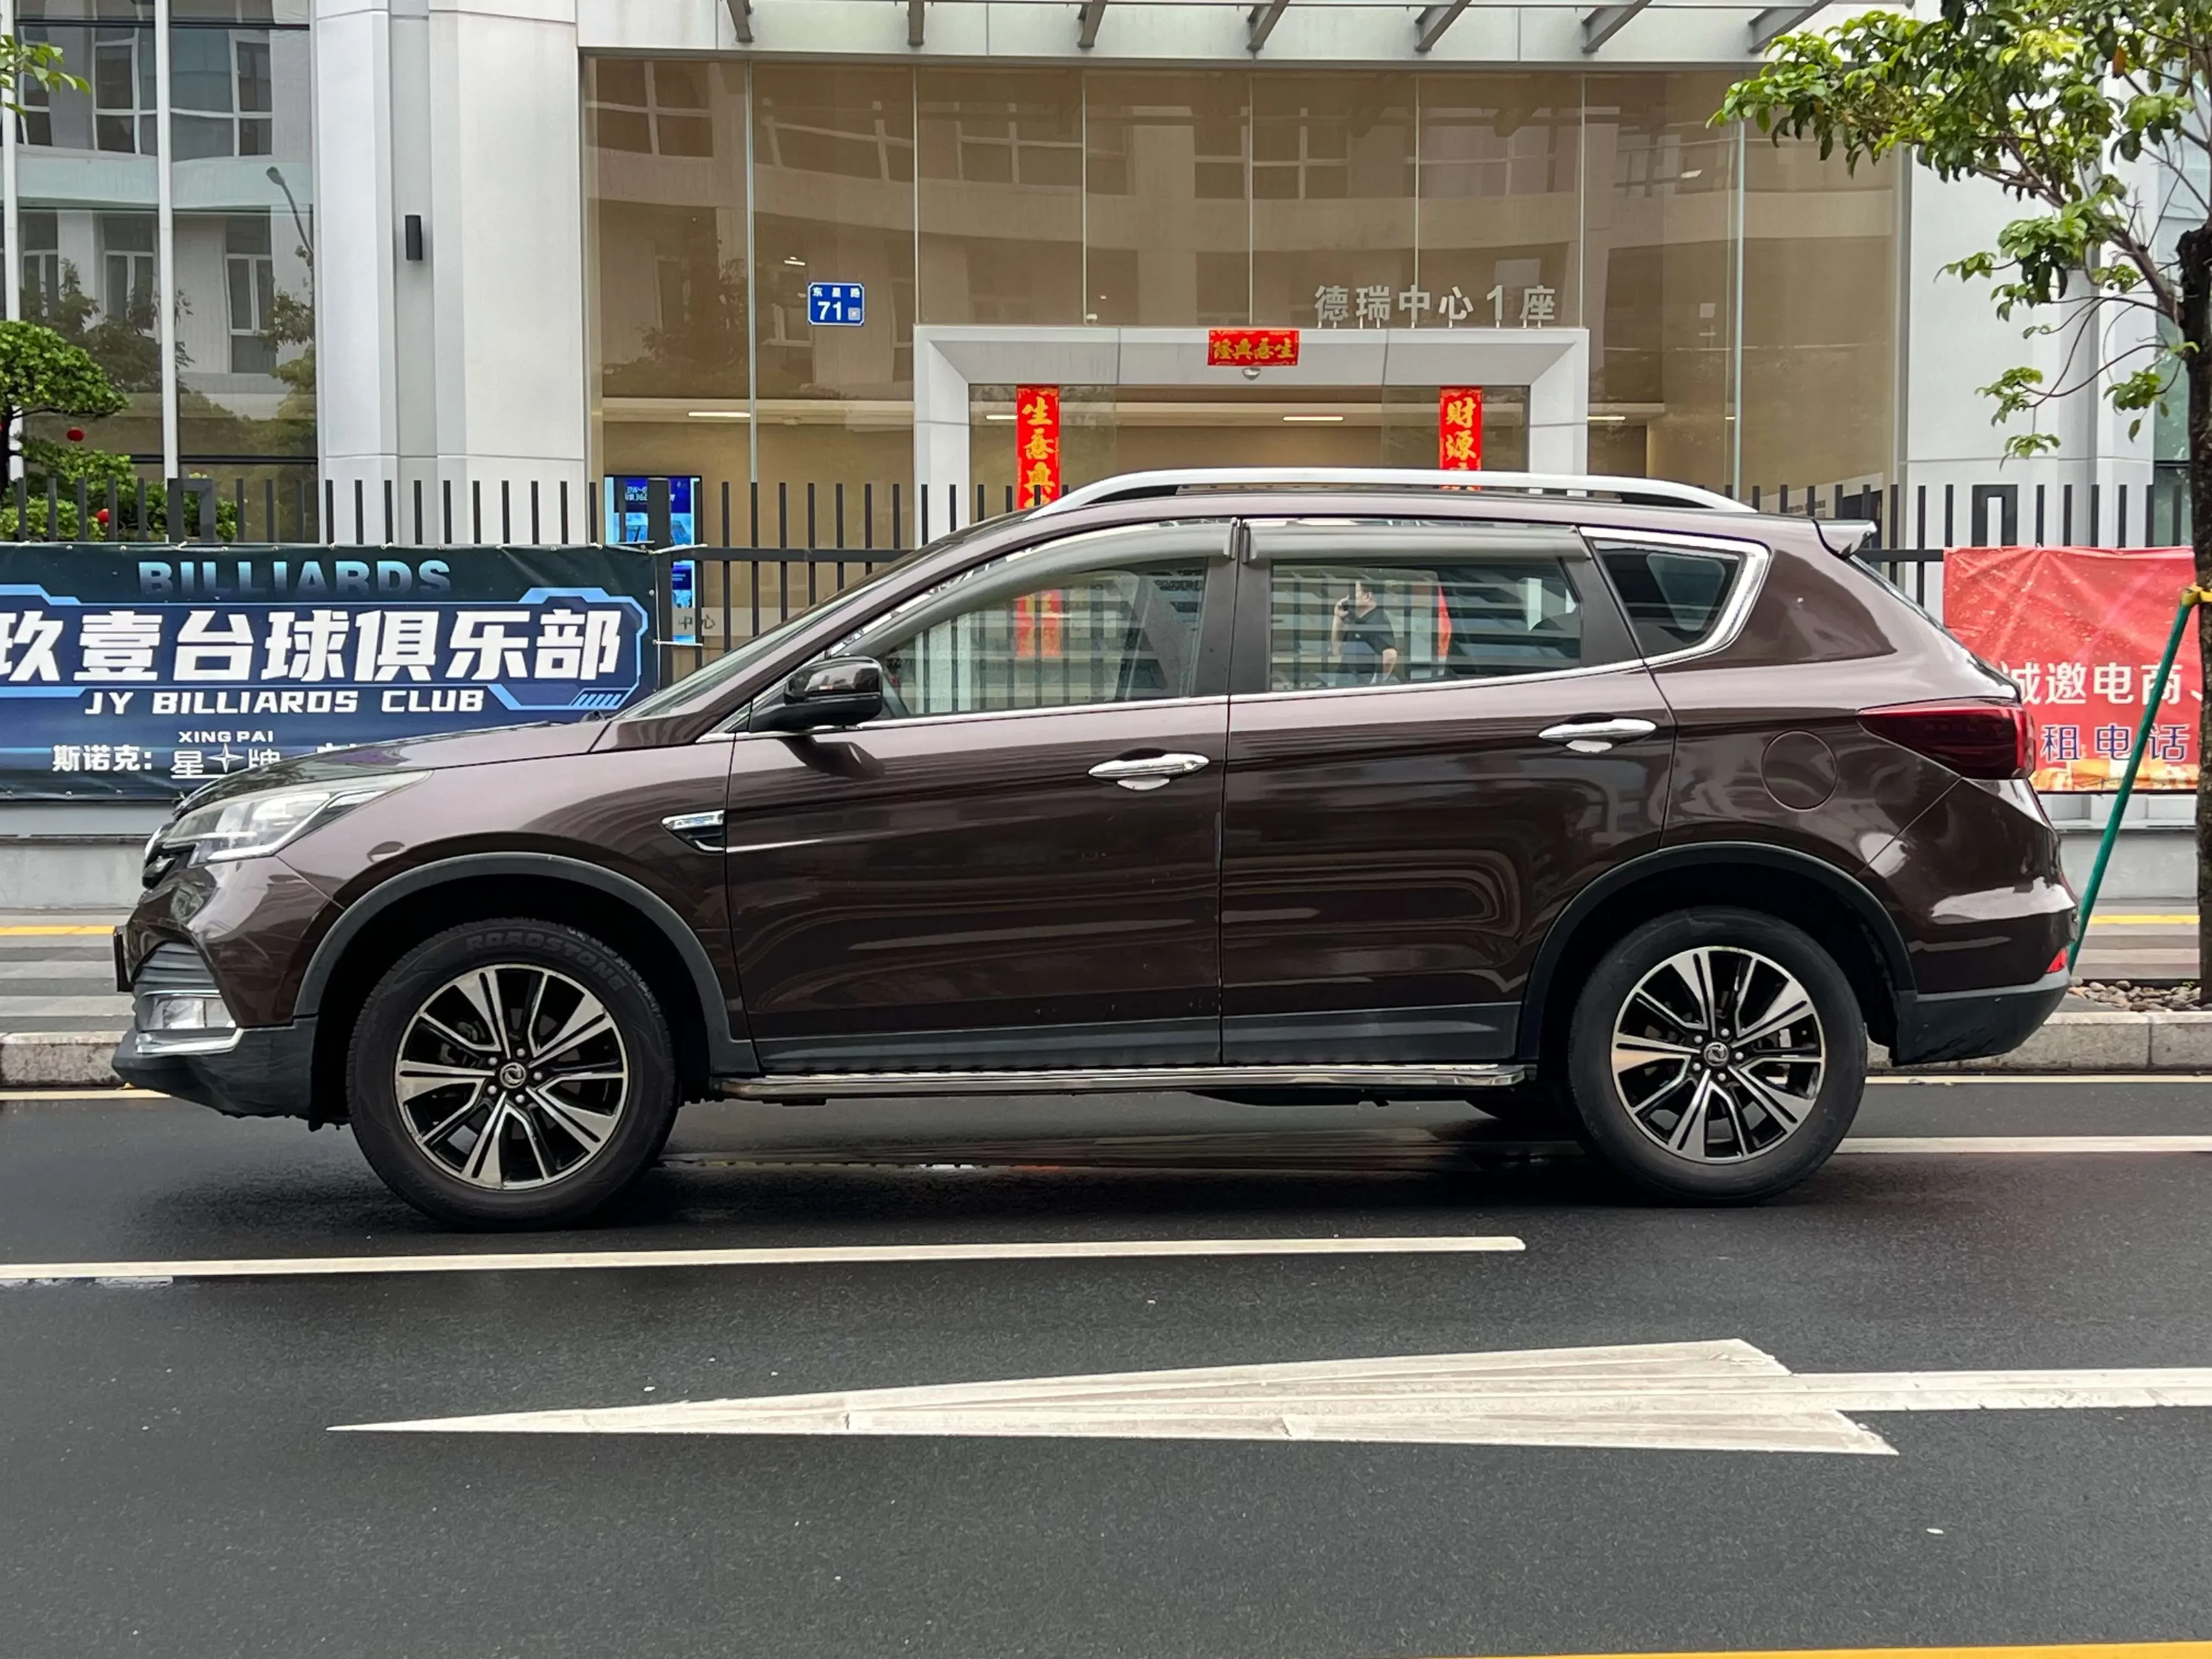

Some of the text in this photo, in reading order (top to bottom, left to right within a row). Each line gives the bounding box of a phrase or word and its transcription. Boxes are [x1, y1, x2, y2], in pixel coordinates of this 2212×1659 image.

[817, 301, 842, 320] 71
[1314, 284, 1555, 322] 德瑞中心1座
[138, 560, 452, 596] BILLIARDS
[0, 609, 622, 682] 玖壹台球俱乐部
[84, 689, 484, 715] JY BILLIARDS CLUB
[178, 730, 274, 743] XING PAI
[467, 932, 628, 991] ROADSTONE
